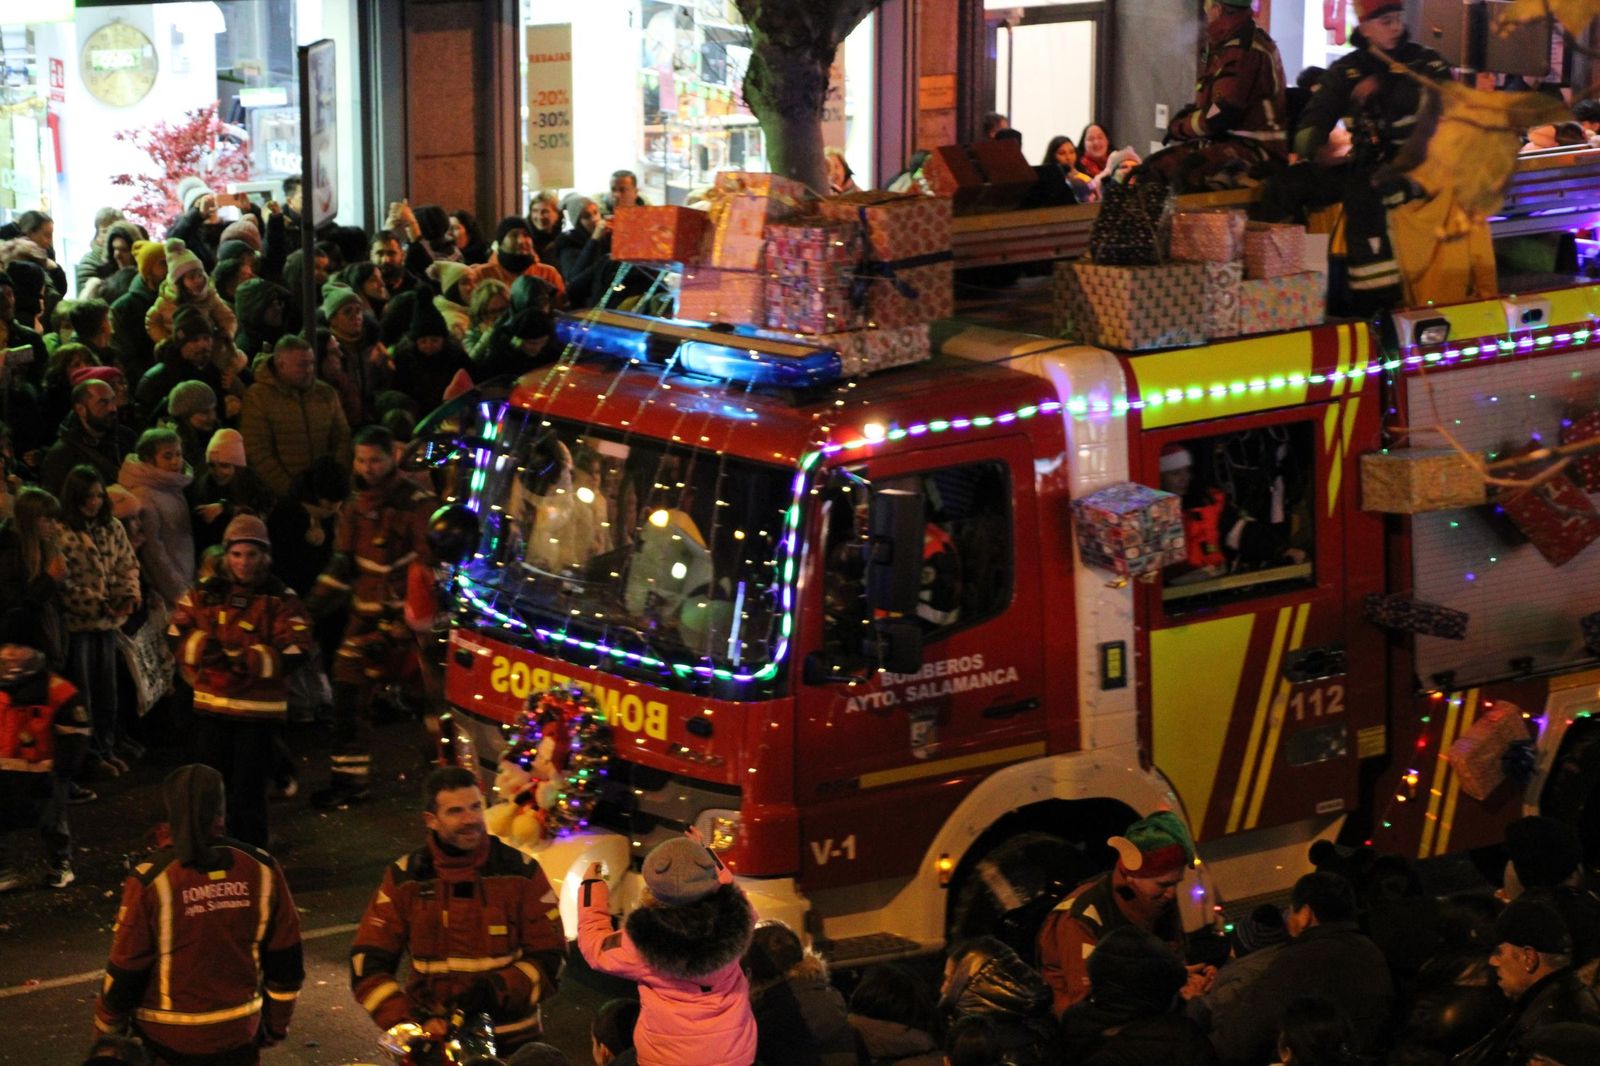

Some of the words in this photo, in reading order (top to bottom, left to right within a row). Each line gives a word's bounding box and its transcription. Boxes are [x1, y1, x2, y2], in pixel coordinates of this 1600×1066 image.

[532, 89, 570, 106] -20%
[532, 110, 570, 128] -30%
[532, 132, 570, 149] -50%
[845, 690, 900, 714] AYTO.
[905, 667, 1019, 702] SALAMANCA
[1291, 684, 1345, 720] 112
[809, 834, 856, 866] V-1
